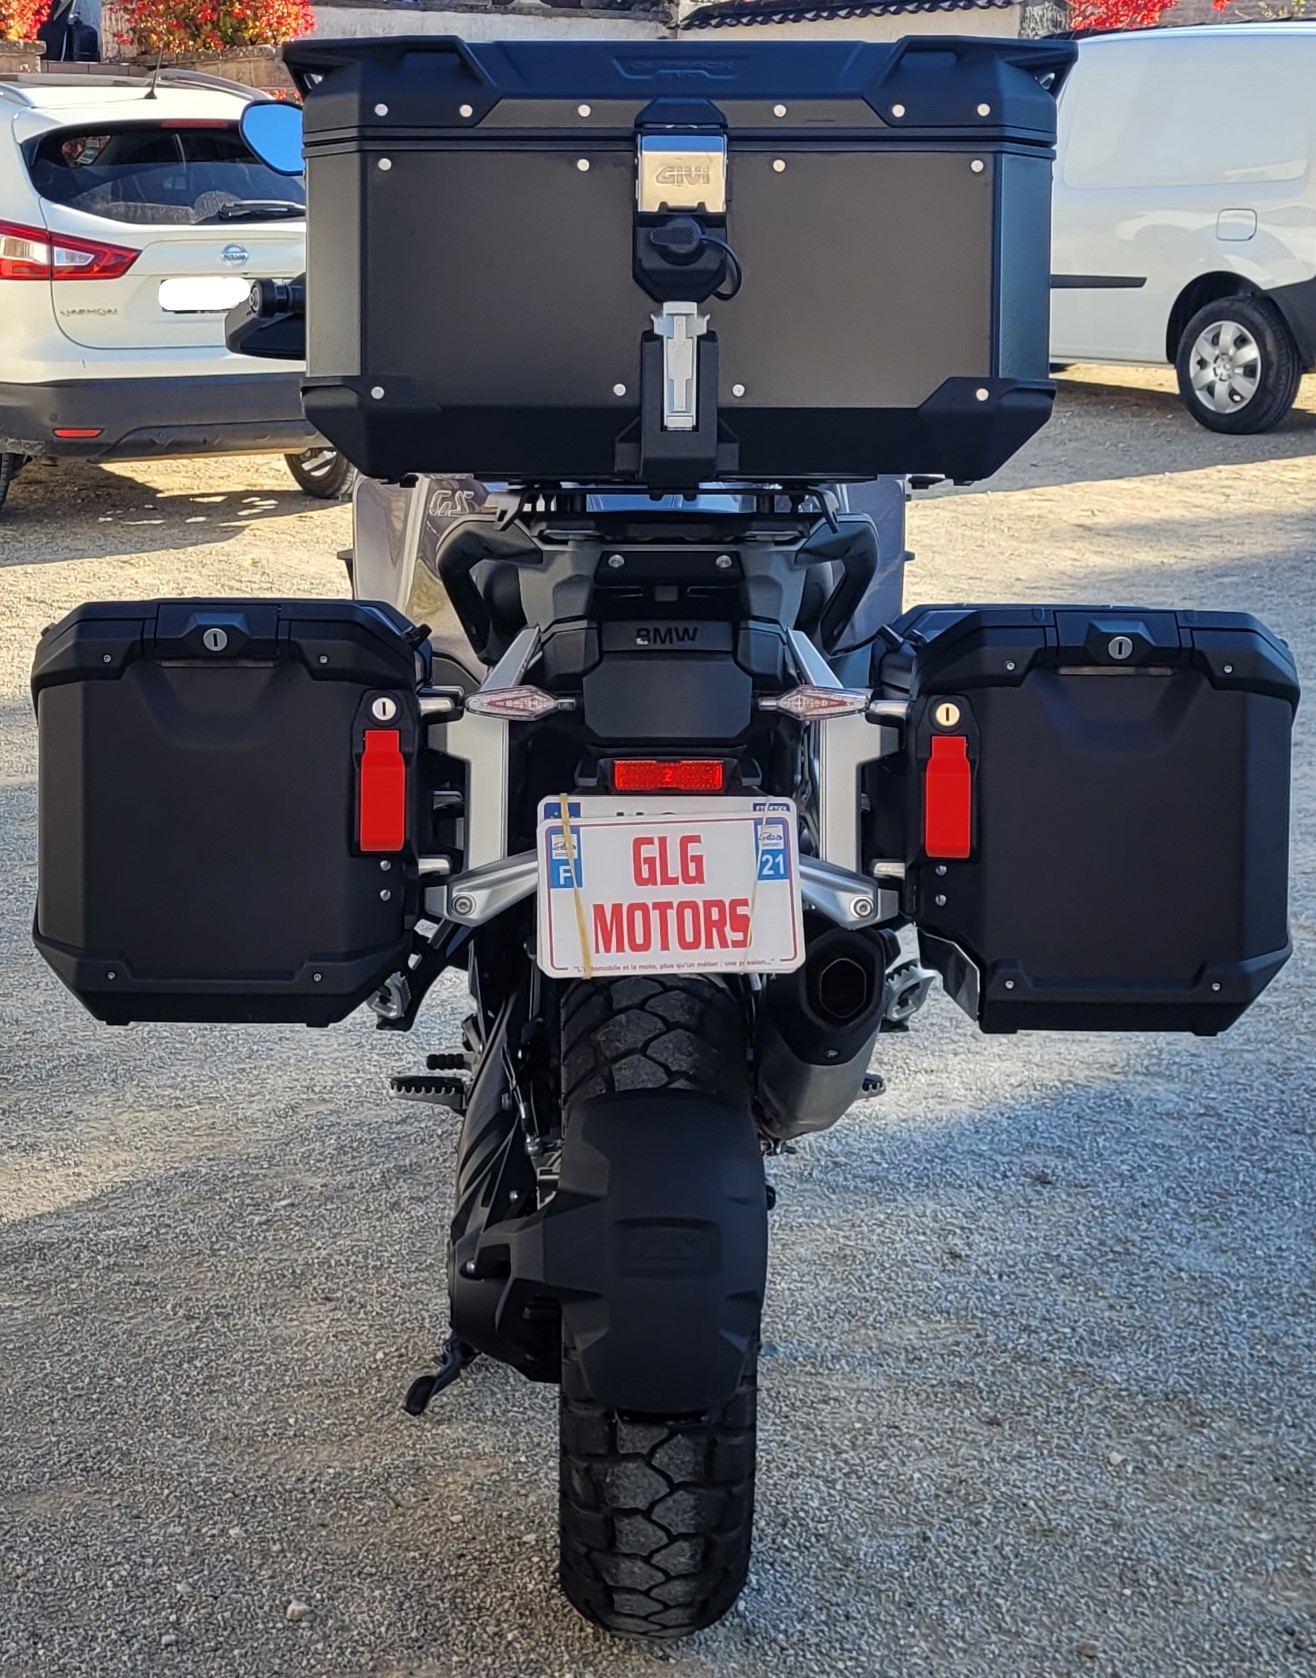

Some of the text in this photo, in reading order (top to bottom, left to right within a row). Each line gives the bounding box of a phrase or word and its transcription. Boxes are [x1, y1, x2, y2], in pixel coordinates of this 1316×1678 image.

[655, 165, 710, 185] GIVI
[635, 626, 699, 645] BMW
[631, 834, 706, 887] GLG
[761, 854, 785, 876] 21
[558, 865, 572, 885] F
[592, 898, 753, 954] MOTORS
